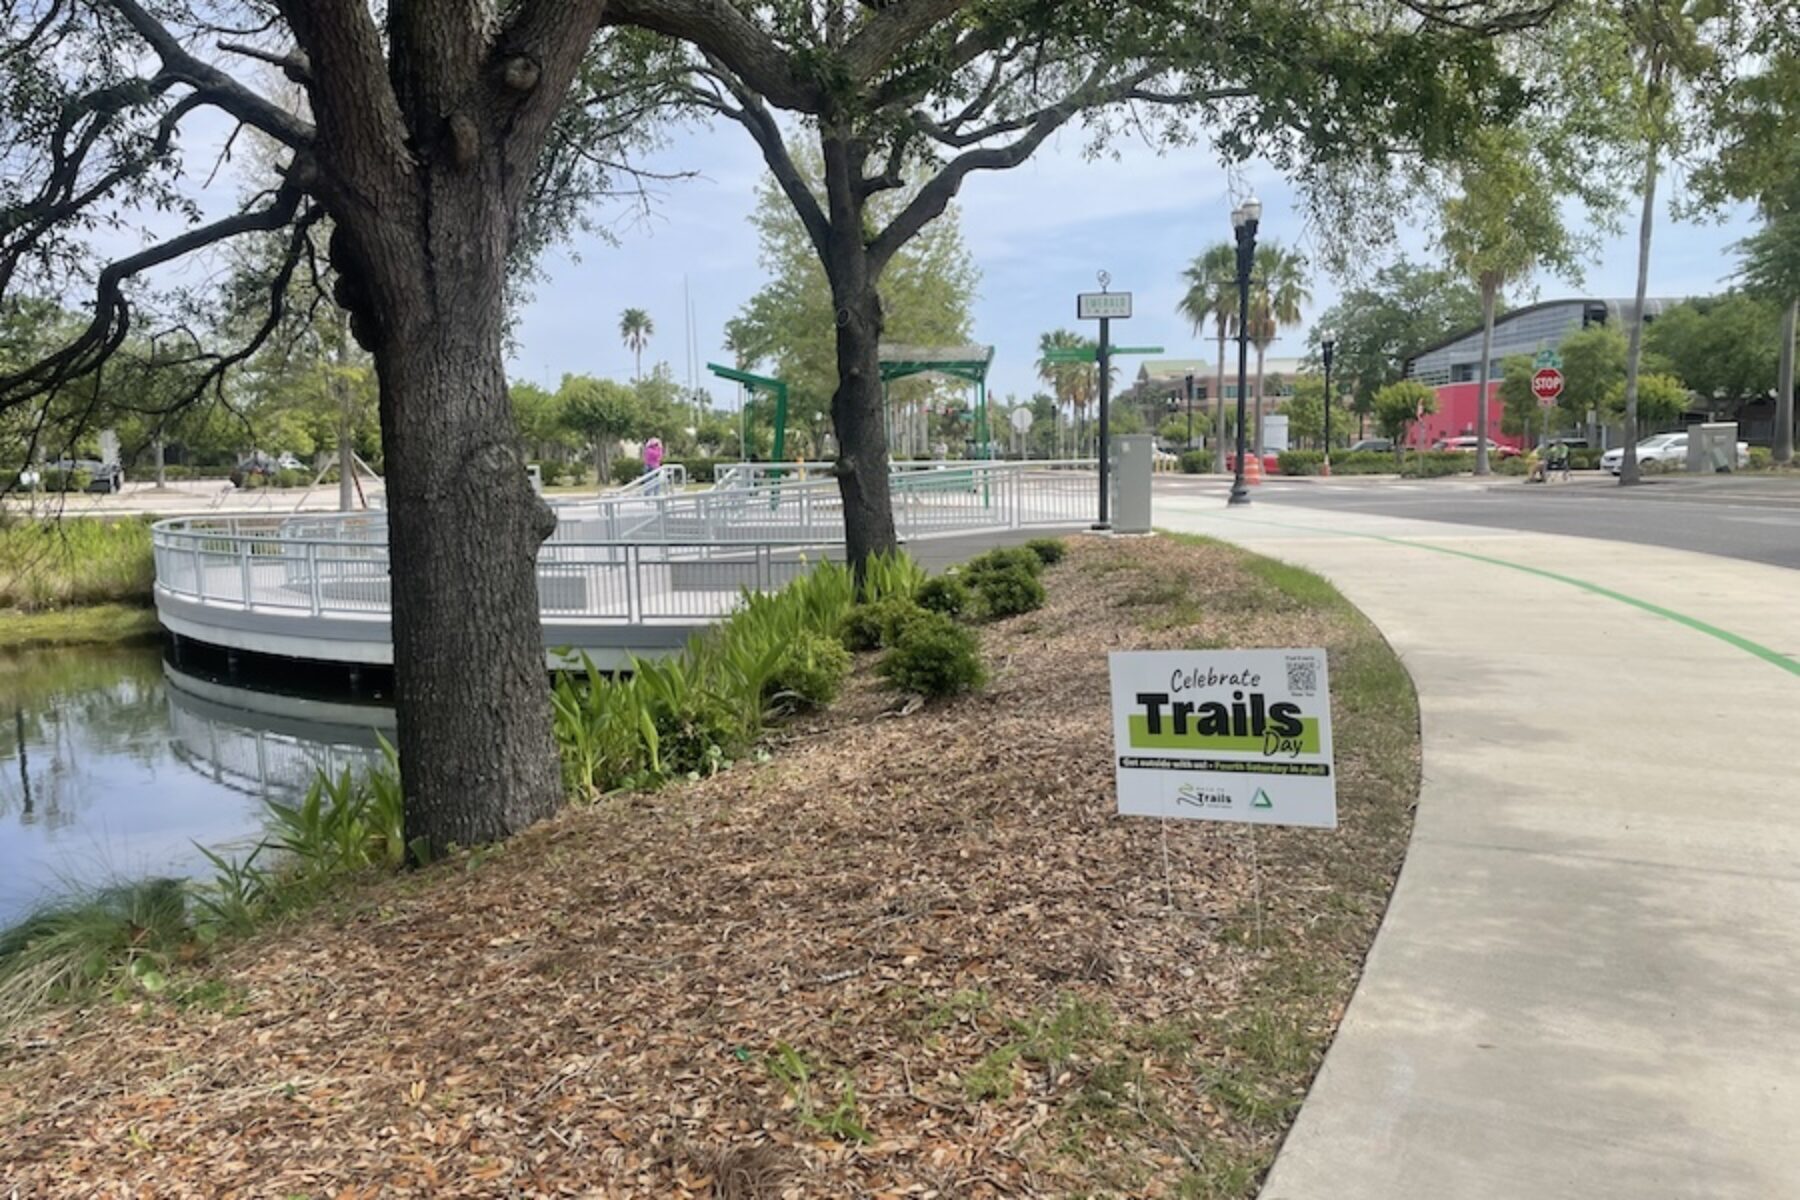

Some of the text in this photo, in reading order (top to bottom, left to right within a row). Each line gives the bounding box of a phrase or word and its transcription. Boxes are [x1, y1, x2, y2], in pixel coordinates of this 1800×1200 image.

[1535, 377, 1560, 390] STOP
[1170, 667, 1261, 693] Celebrate
[1136, 690, 1304, 738] Trails
[1262, 730, 1303, 758] Day
[1198, 792, 1232, 803] Trails
